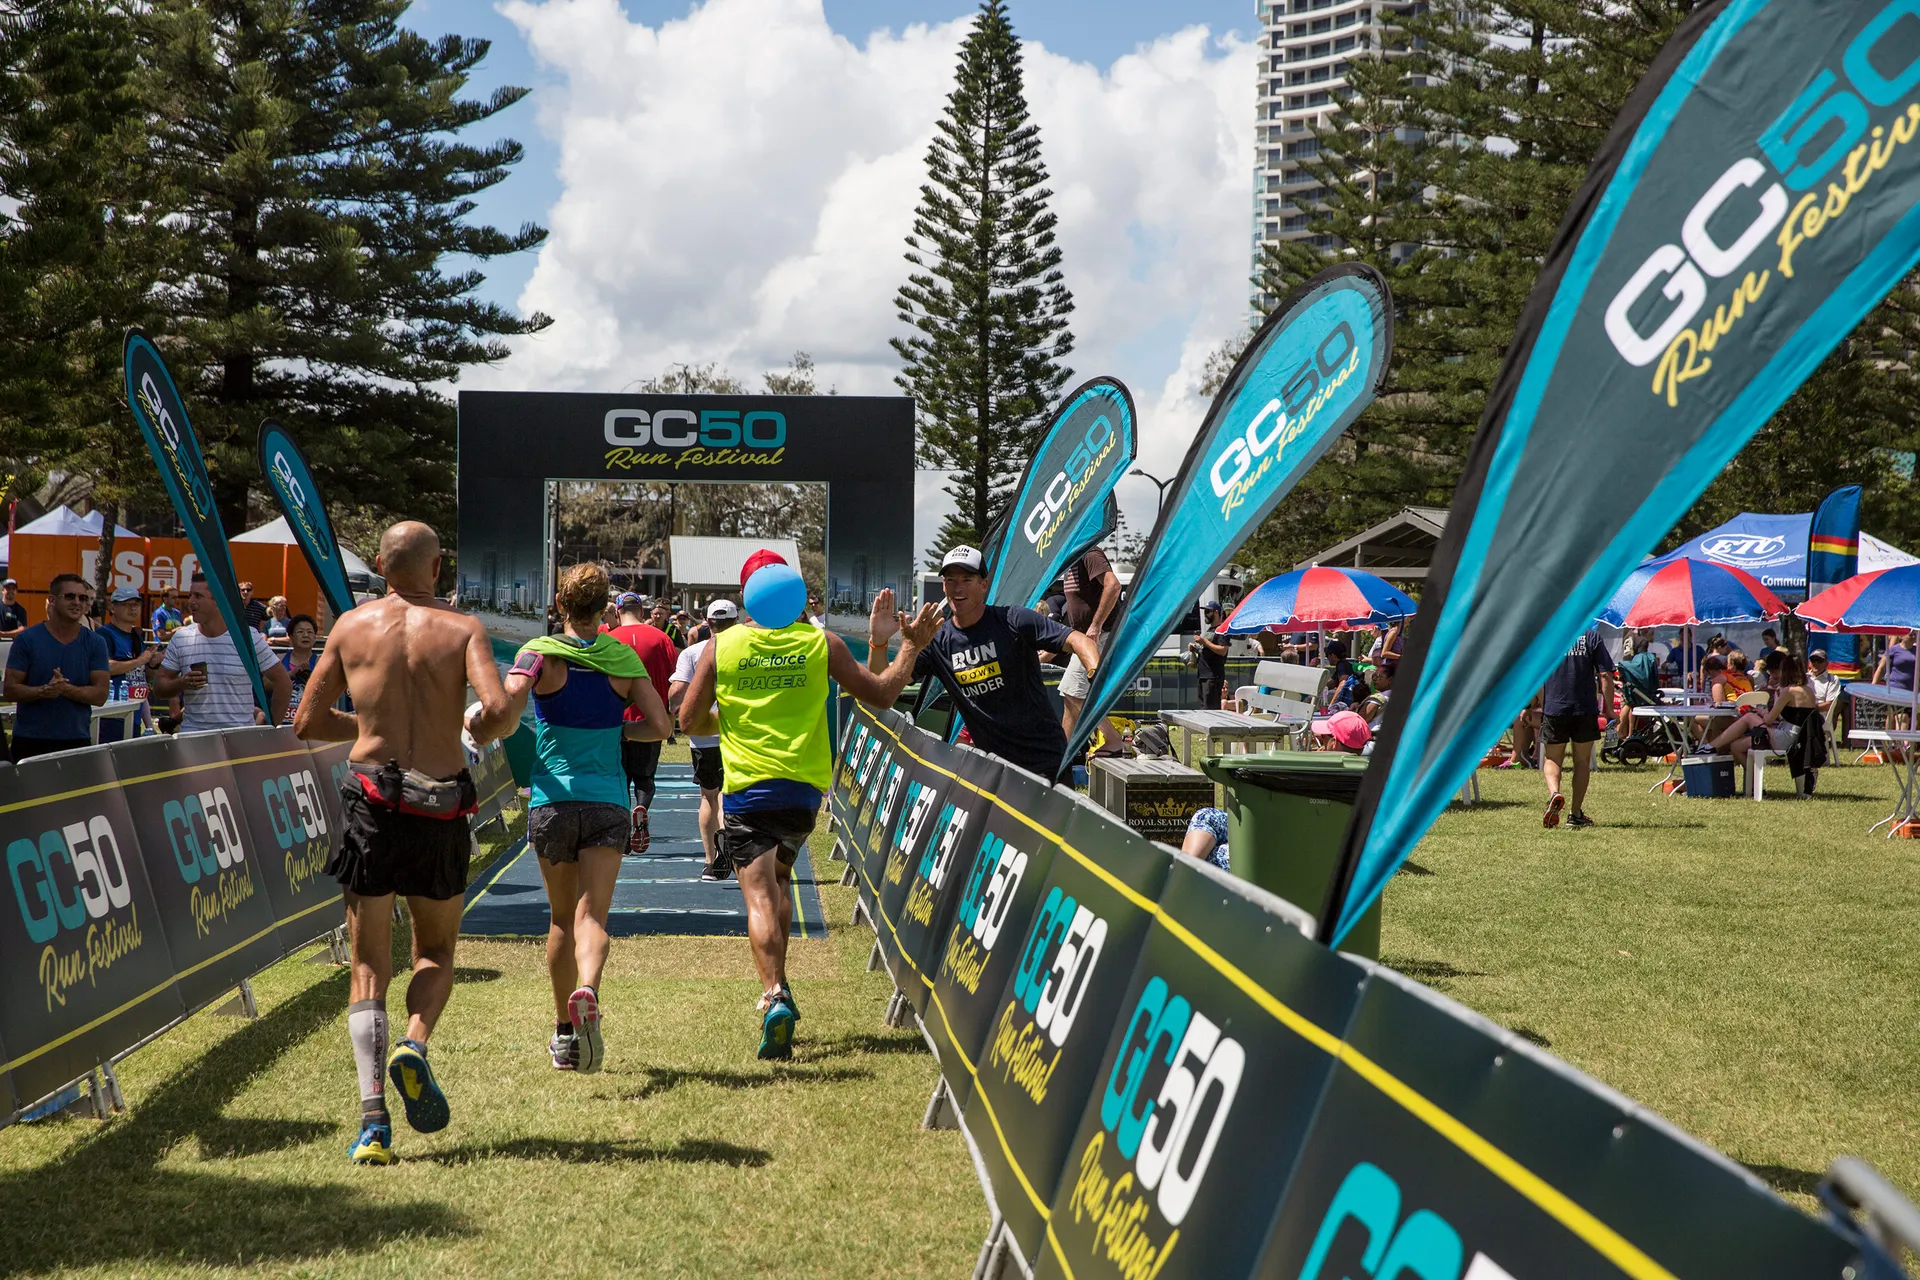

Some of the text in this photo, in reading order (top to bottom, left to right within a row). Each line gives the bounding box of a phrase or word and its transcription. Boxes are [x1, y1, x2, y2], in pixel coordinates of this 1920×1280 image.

[1652, 269, 1769, 407] Run
[137, 388, 207, 523] Run Festival
[141, 371, 211, 517] GC50
[604, 408, 787, 448] GC50
[1210, 320, 1355, 498] GC50
[1221, 346, 1360, 521] Run Festival
[274, 450, 330, 557] GC50
[605, 446, 786, 470] Run Festival
[1024, 414, 1113, 544] GC50
[1036, 430, 1117, 558] Run Festival
[271, 465, 329, 562] Run Festival
[1761, 575, 1807, 587] Commun
[134, 687, 147, 699] 627
[737, 674, 807, 691] PACER
[738, 653, 807, 671] galeforce
[951, 642, 998, 670] RUN
[960, 665, 996, 682] DOWN
[961, 677, 1005, 699] UNDER
[162, 786, 245, 885] GC50
[262, 769, 328, 849] GC50
[893, 779, 938, 855] GC50
[919, 801, 970, 891] GC50
[1128, 818, 1157, 826] ROYAL
[1162, 808, 1179, 816] RSH
[6, 814, 131, 944] GC50
[190, 858, 255, 941] Run Festival
[285, 850, 309, 896] Run
[958, 831, 1029, 951] GC50
[39, 902, 143, 1013] Run Festival
[950, 935, 992, 996] Festival
[1013, 885, 1109, 1048] GC50
[989, 1000, 1063, 1106] Run Festival
[1101, 974, 1247, 1227] GC50
[1068, 1130, 1181, 1280] Run Festival
